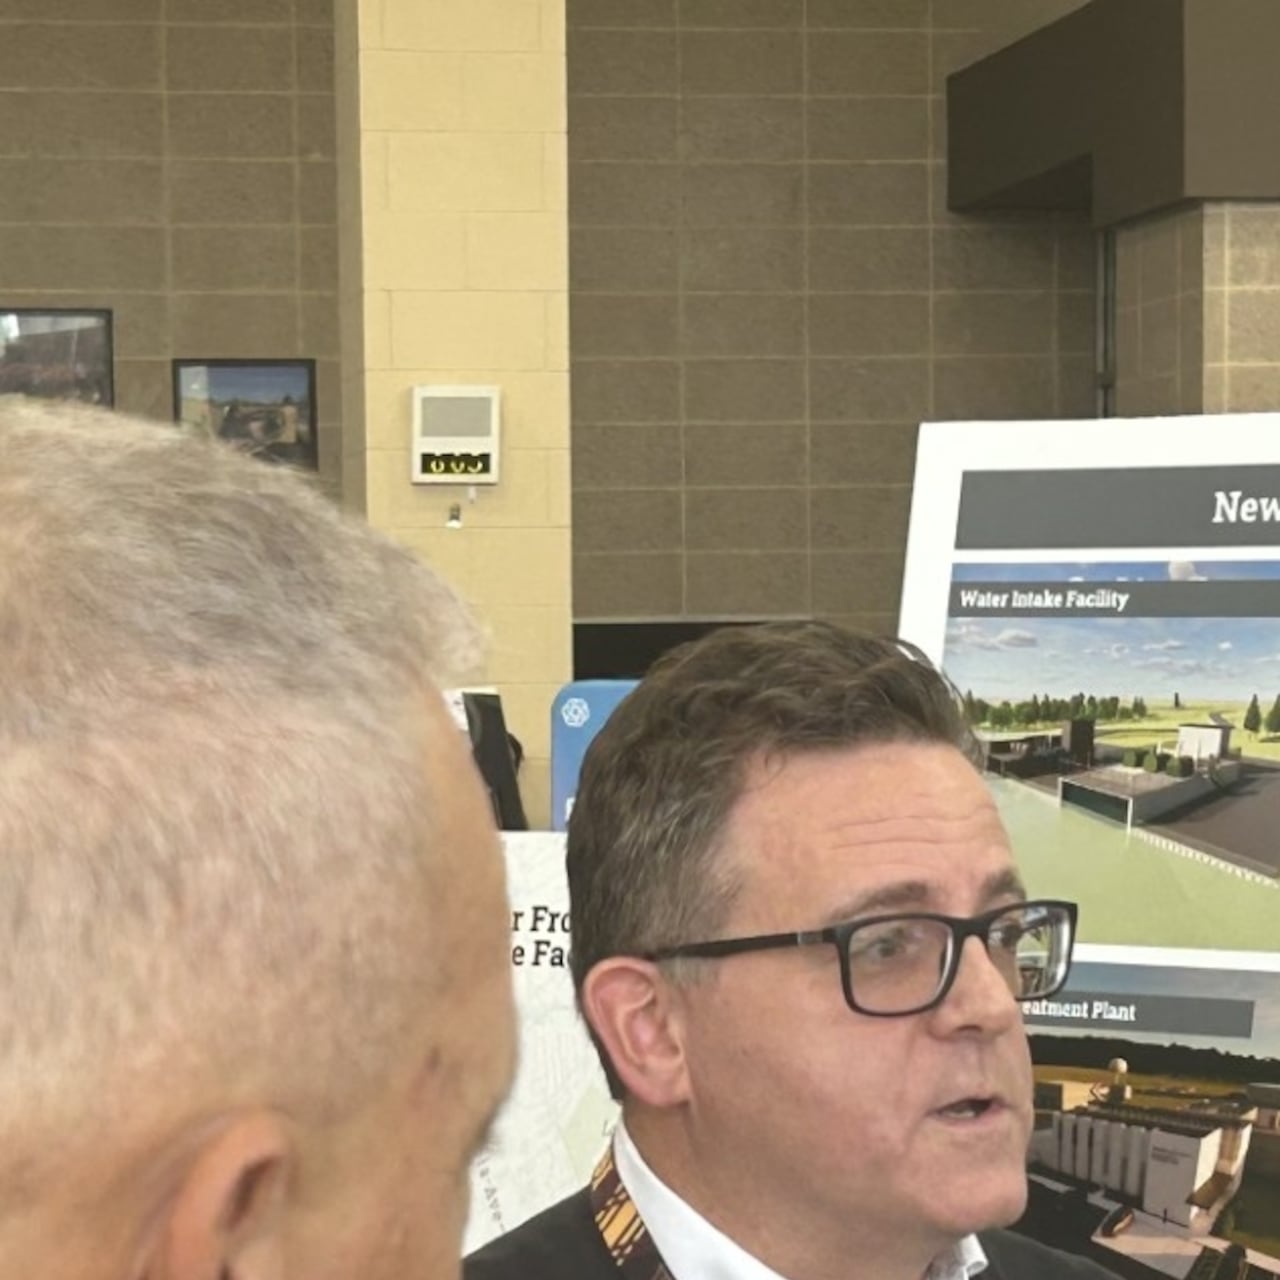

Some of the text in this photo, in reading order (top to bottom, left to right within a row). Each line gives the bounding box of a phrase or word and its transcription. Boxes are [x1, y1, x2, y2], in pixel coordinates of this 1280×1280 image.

[960, 589, 1130, 612] Water Intake Facility
[529, 905, 571, 933] Fro
[1021, 998, 1136, 1021] eatment Plant
